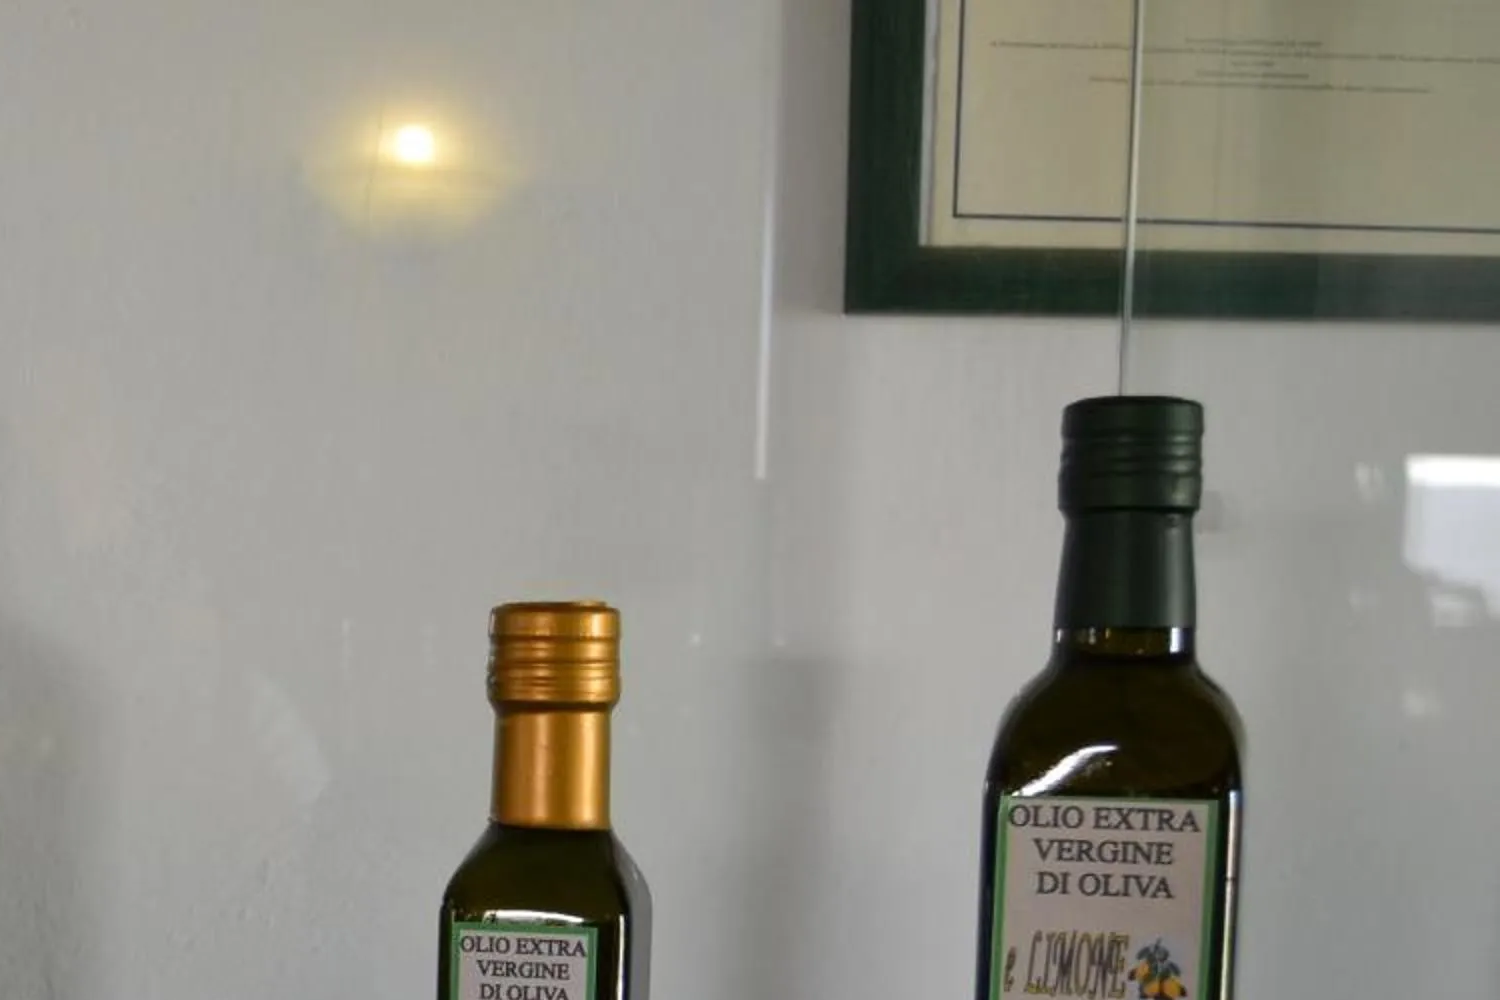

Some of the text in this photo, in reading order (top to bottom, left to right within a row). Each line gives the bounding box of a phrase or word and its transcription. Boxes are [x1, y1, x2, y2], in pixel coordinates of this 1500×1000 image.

[1008, 805, 1200, 832] OLIO EXTRA
[1034, 838, 1173, 865] VERGINE
[1037, 872, 1174, 898] DI OLIVA
[460, 935, 587, 957] OLIO EXTRA
[477, 959, 570, 980] VERGINE
[480, 983, 502, 1000] DI
